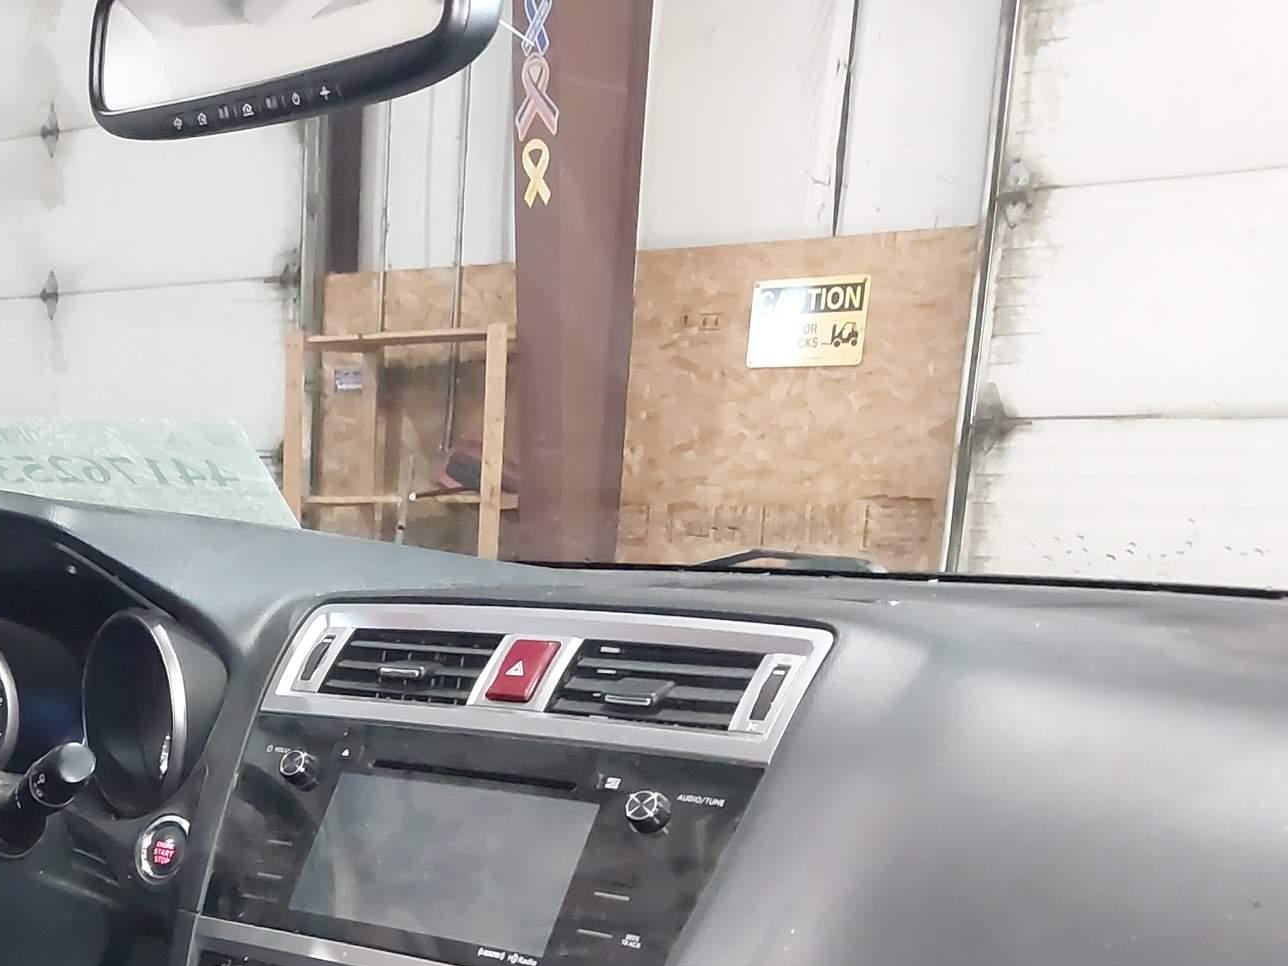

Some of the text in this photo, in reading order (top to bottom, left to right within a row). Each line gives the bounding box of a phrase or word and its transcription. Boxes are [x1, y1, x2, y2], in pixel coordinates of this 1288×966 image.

[758, 284, 862, 313] CATION
[676, 794, 726, 808] AUDIO/TUNE
[153, 847, 175, 858] START
[153, 855, 171, 865] STOP
